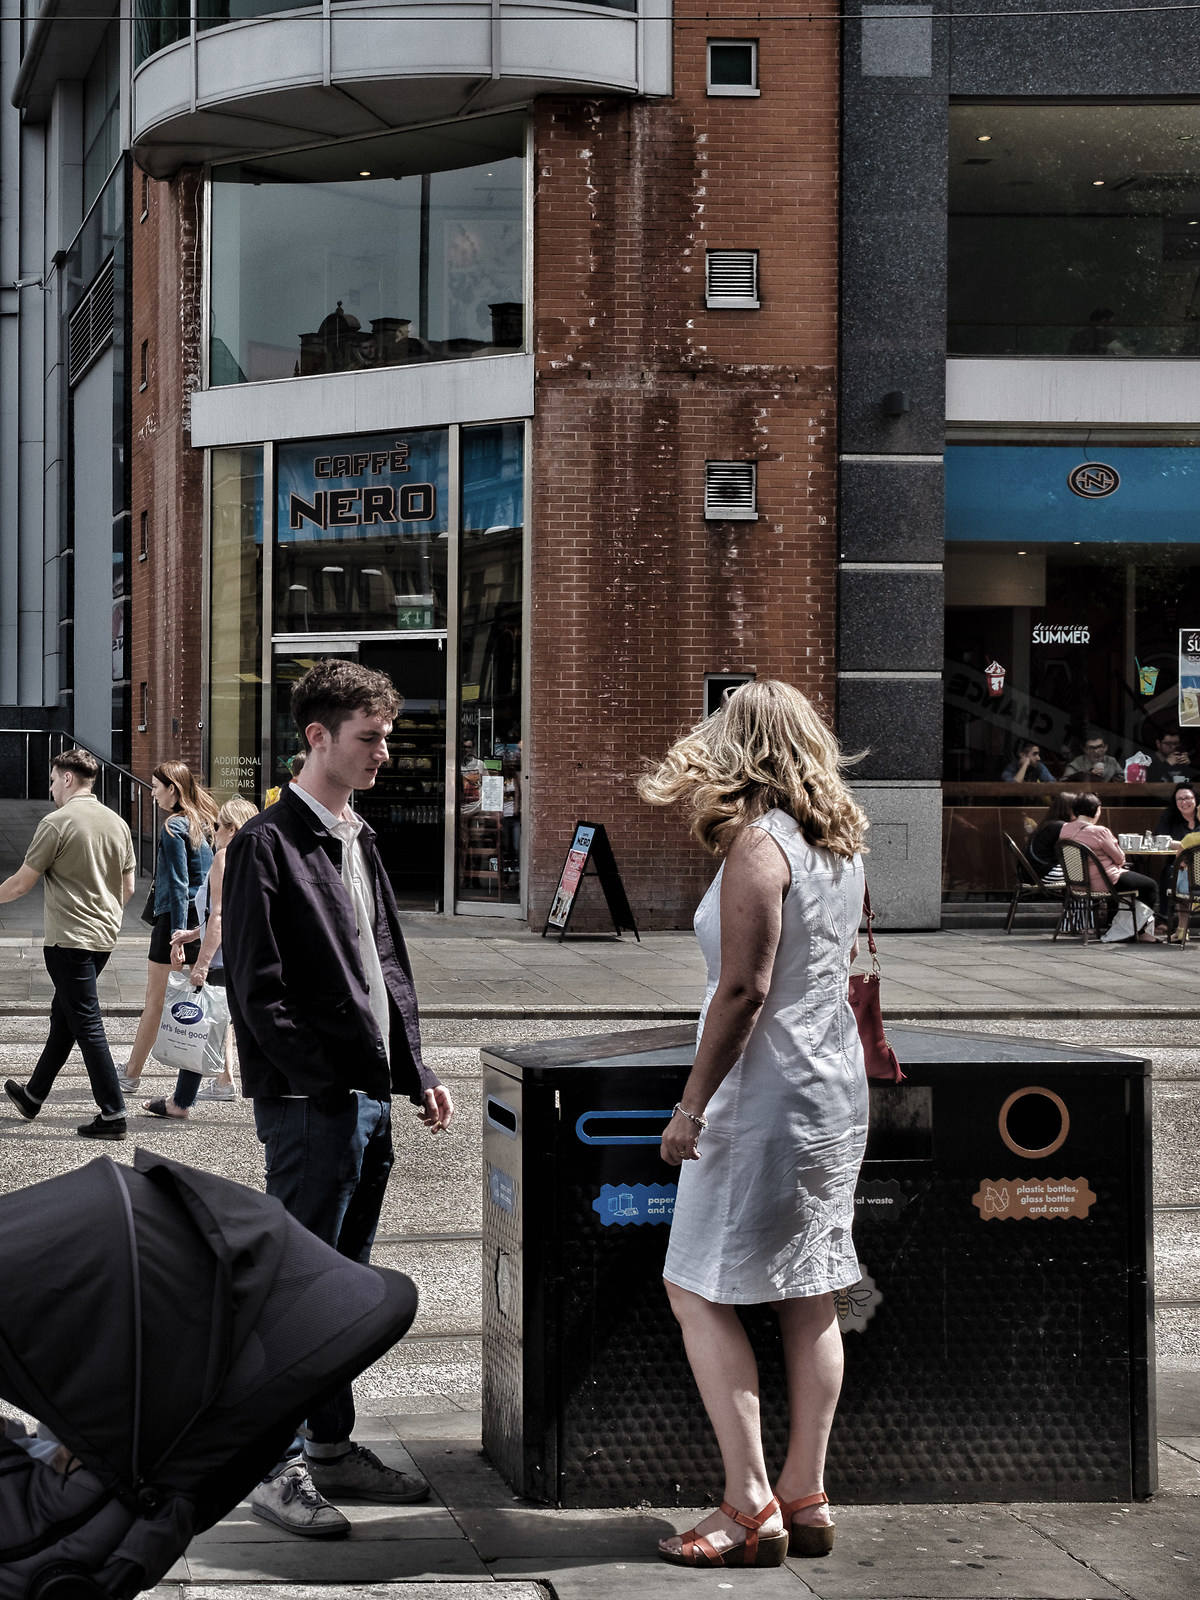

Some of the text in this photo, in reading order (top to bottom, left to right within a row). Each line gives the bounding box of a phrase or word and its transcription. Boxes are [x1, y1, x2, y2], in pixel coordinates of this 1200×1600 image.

[290, 482, 436, 530] NERO
[1034, 623, 1089, 631] destination
[1032, 630, 1090, 644] SUMMER
[213, 756, 261, 765] ADDITIONAL
[220, 767, 254, 777] SEATING
[220, 779, 255, 788] UPSTAIRS
[174, 1027, 187, 1036] feel
[188, 1031, 208, 1040] good
[1016, 1184, 1079, 1195] plastic bottles,
[647, 1197, 675, 1206] paper
[1020, 1194, 1075, 1205] glass bottles
[647, 1206, 665, 1214] and
[1029, 1205, 1069, 1213] and cans
